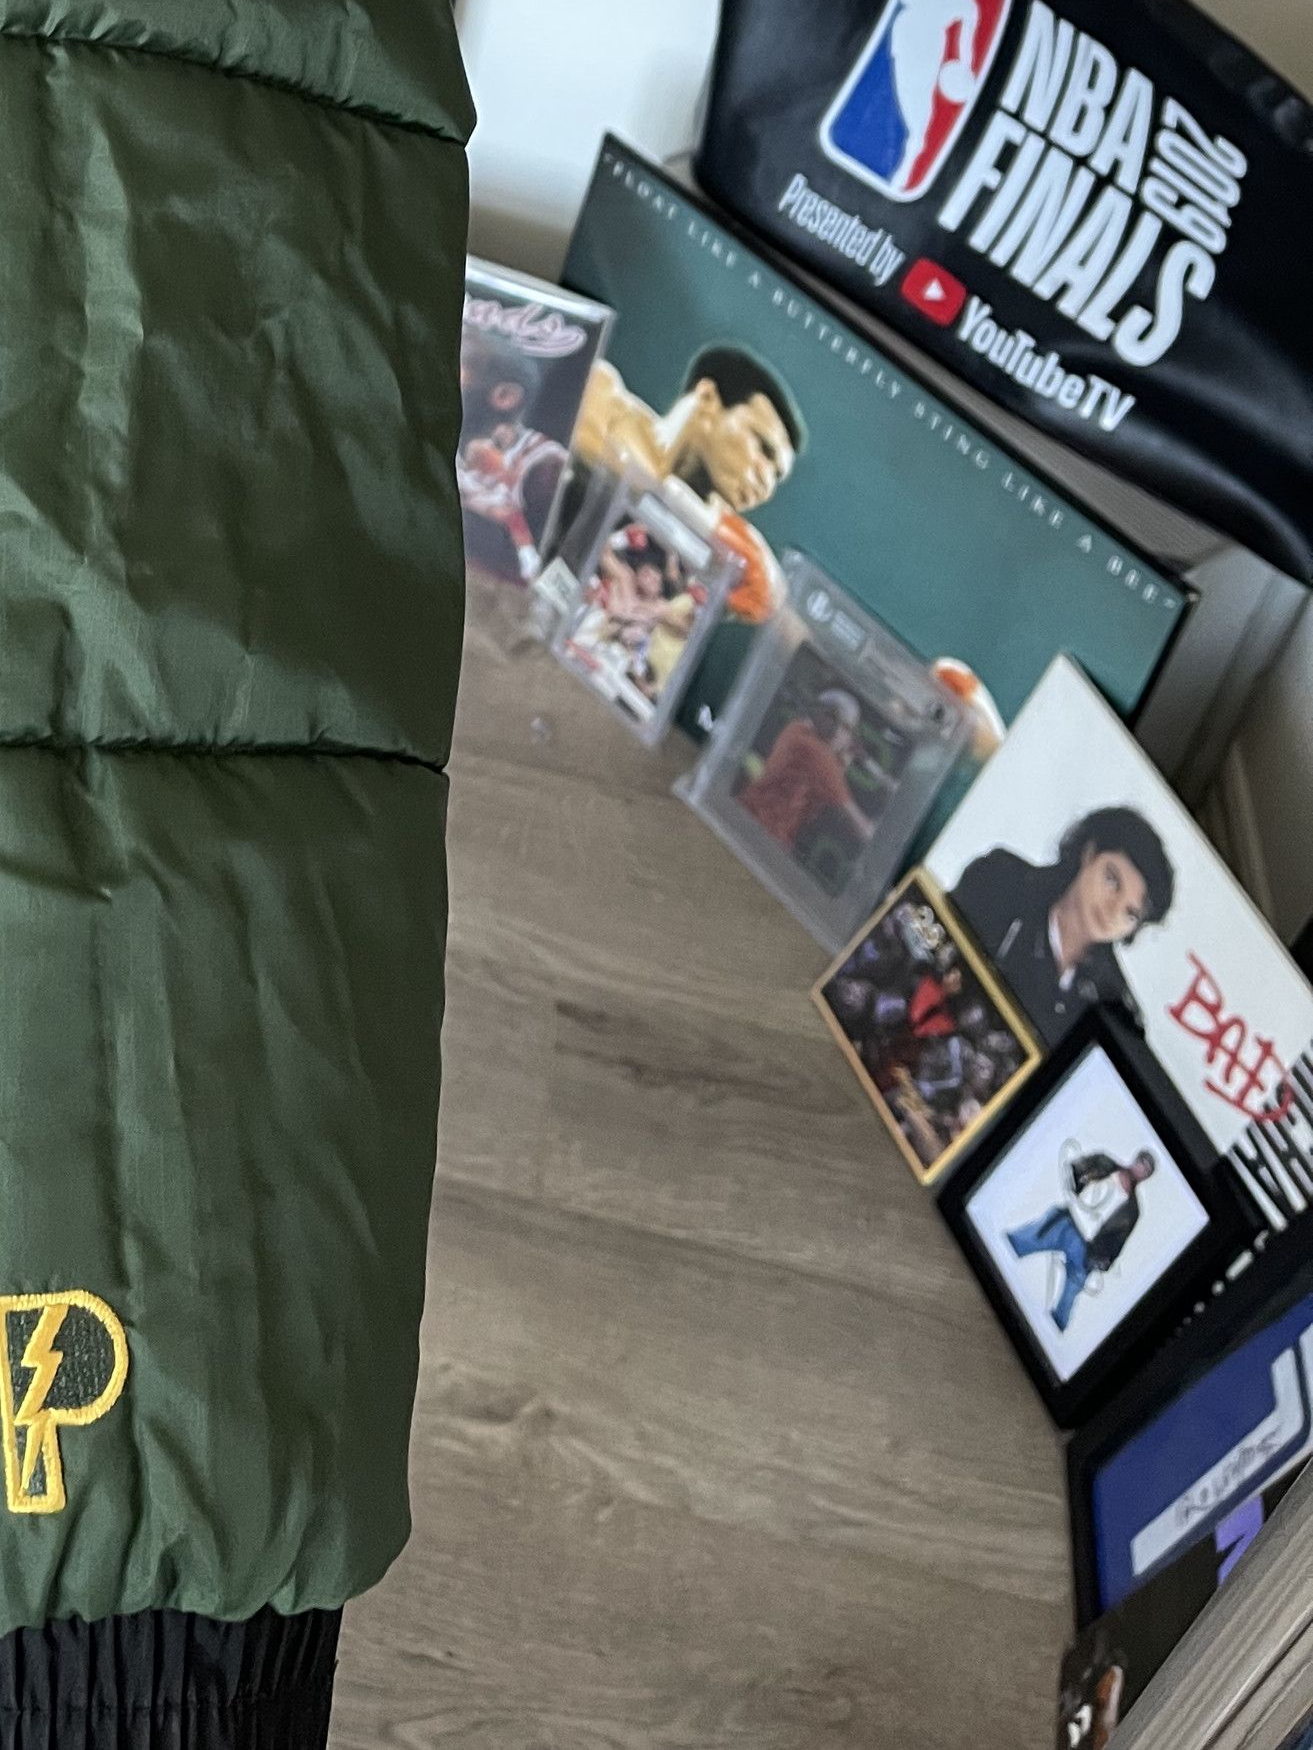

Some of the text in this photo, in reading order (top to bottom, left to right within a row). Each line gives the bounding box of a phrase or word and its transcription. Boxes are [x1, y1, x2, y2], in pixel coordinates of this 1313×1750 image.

[778, 172, 906, 287] Presented by
[937, 109, 1216, 367] FINALS
[1141, 96, 1248, 255] 2019
[687, 220, 738, 268] LIKE
[771, 287, 902, 399] BUTTERFLY
[914, 400, 989, 471] STING
[1000, 471, 1065, 530] LIKE
[1075, 534, 1093, 554] A
[1167, 948, 1296, 1123] BAD
